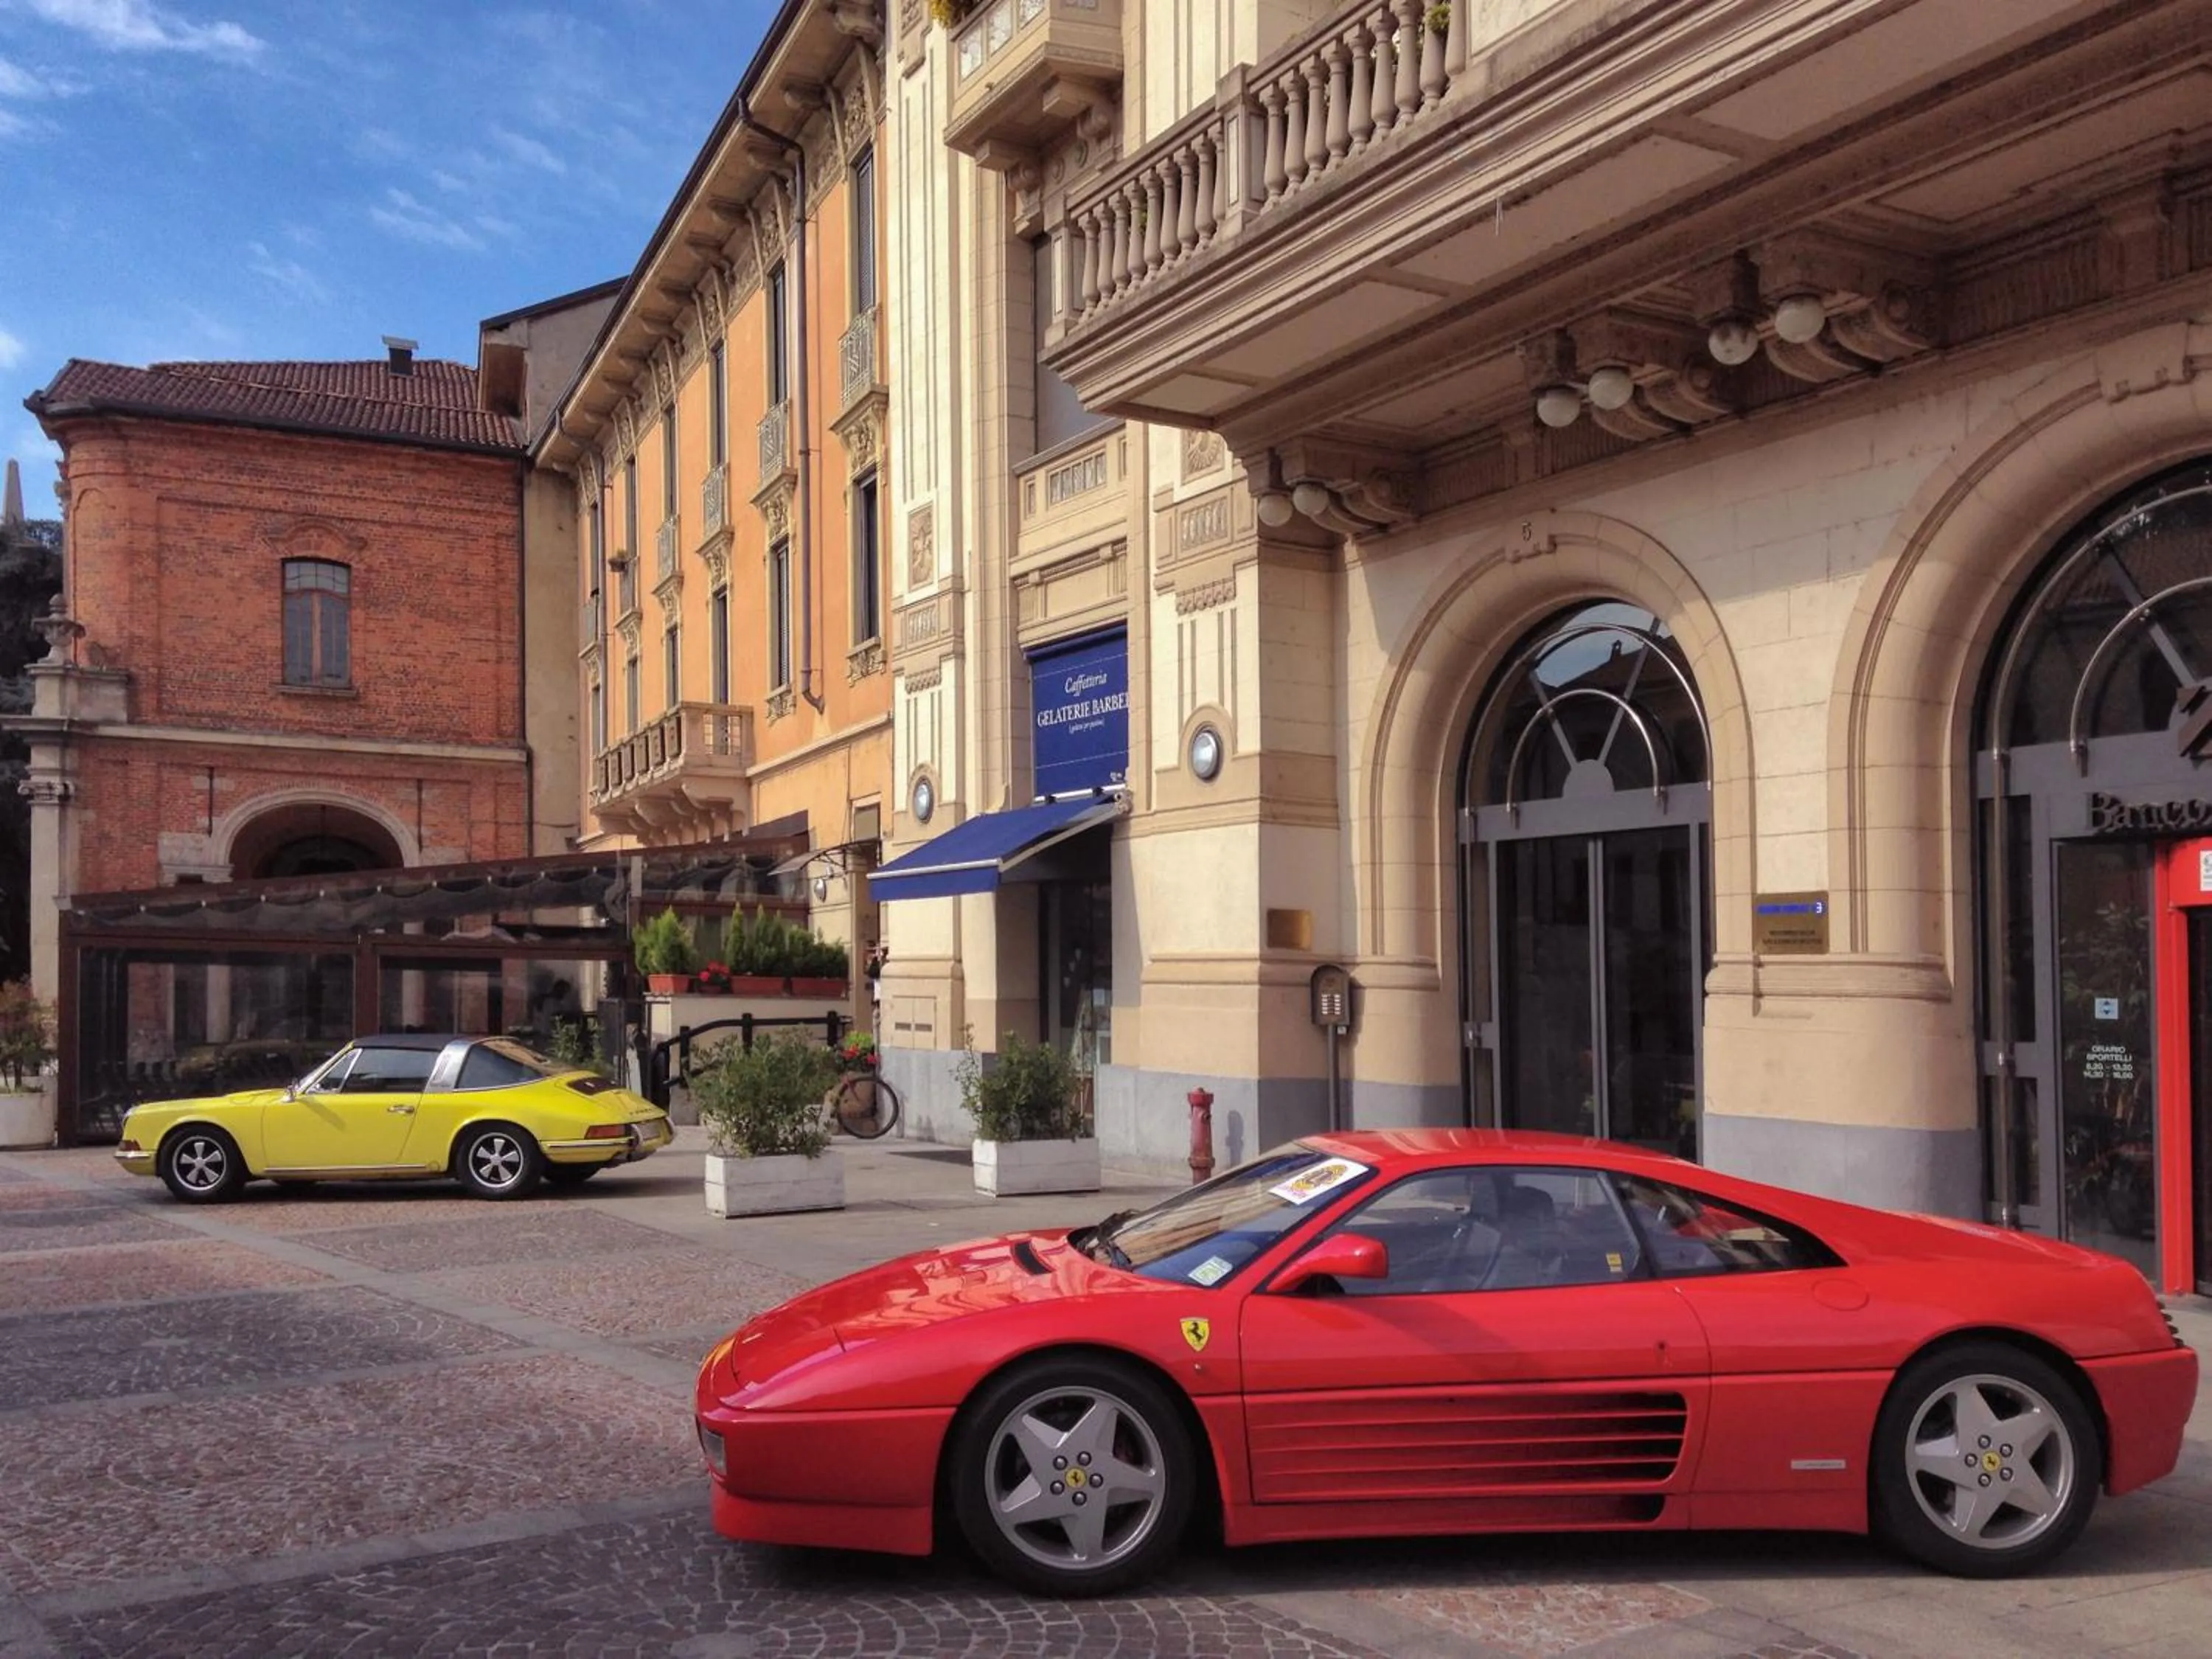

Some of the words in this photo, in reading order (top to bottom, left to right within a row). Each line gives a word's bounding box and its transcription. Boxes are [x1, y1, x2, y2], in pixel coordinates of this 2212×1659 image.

[1037, 701, 1091, 727] GELATERIE
[2085, 791, 2211, 832] Banco
[2086, 1054, 2132, 1062] SPORTELLI
[2091, 1045, 2126, 1054] ORARIO
